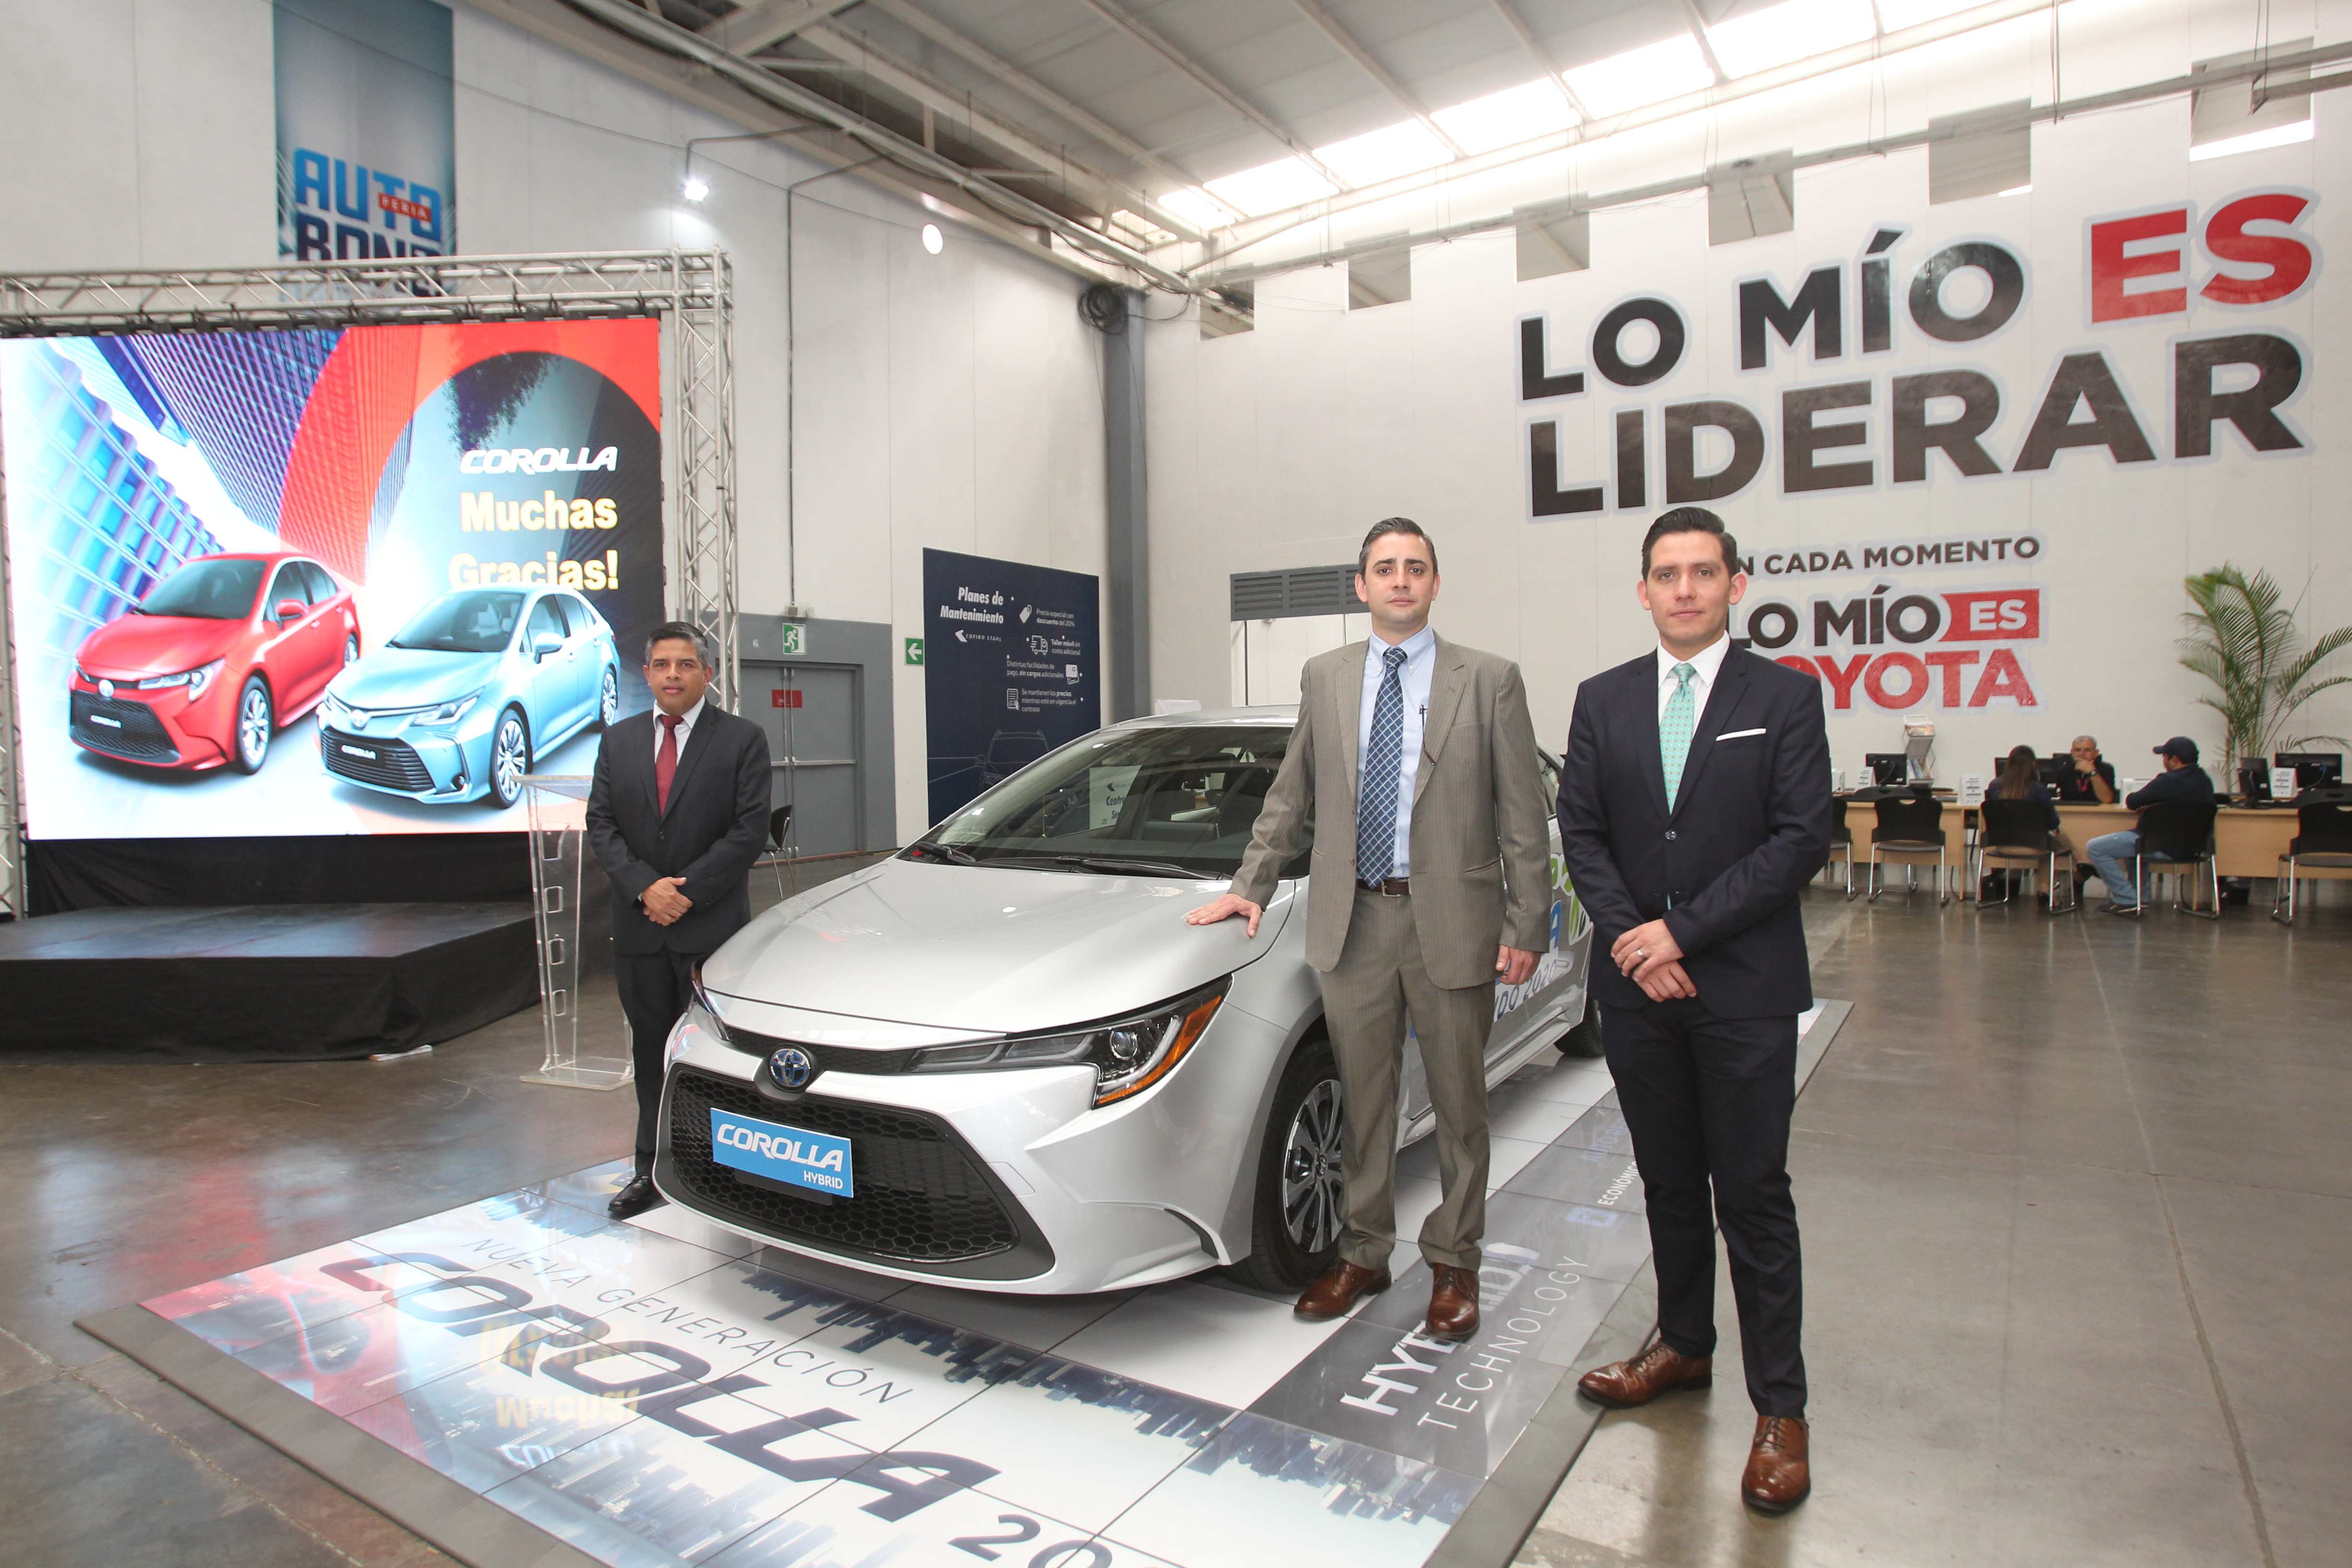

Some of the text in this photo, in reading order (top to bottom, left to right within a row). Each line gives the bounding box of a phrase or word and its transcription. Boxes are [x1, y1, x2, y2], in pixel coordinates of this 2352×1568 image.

[294, 147, 442, 242] AUTO
[381, 194, 429, 220] FERIA
[1521, 194, 2311, 401] LO MÍO ES
[1531, 333, 2304, 517] LIDERAR
[460, 446, 618, 475] COROLLA
[460, 490, 618, 532] Muchas
[448, 550, 619, 591] Gracias!
[1736, 537, 2040, 575] N CADA MOMENTO
[940, 605, 1004, 624] Mantenimiento
[958, 586, 1004, 605] Planes de
[1814, 584, 1941, 647] MÍO
[1970, 599, 2027, 631] ES
[753, 639, 759, 648] 6
[1036, 617, 1058, 625] descuento
[1775, 649, 2038, 709] YOTA
[717, 1124, 844, 1172] COROLLA
[804, 1171, 843, 1189] HYBRID
[461, 1238, 591, 1288] NUEVA
[597, 1288, 914, 1404] GENERACIÓN
[1417, 1256, 1588, 1429] TECHNOLOGY
[319, 1252, 1002, 1522] COROLLA
[947, 1514, 1113, 1568] 20
